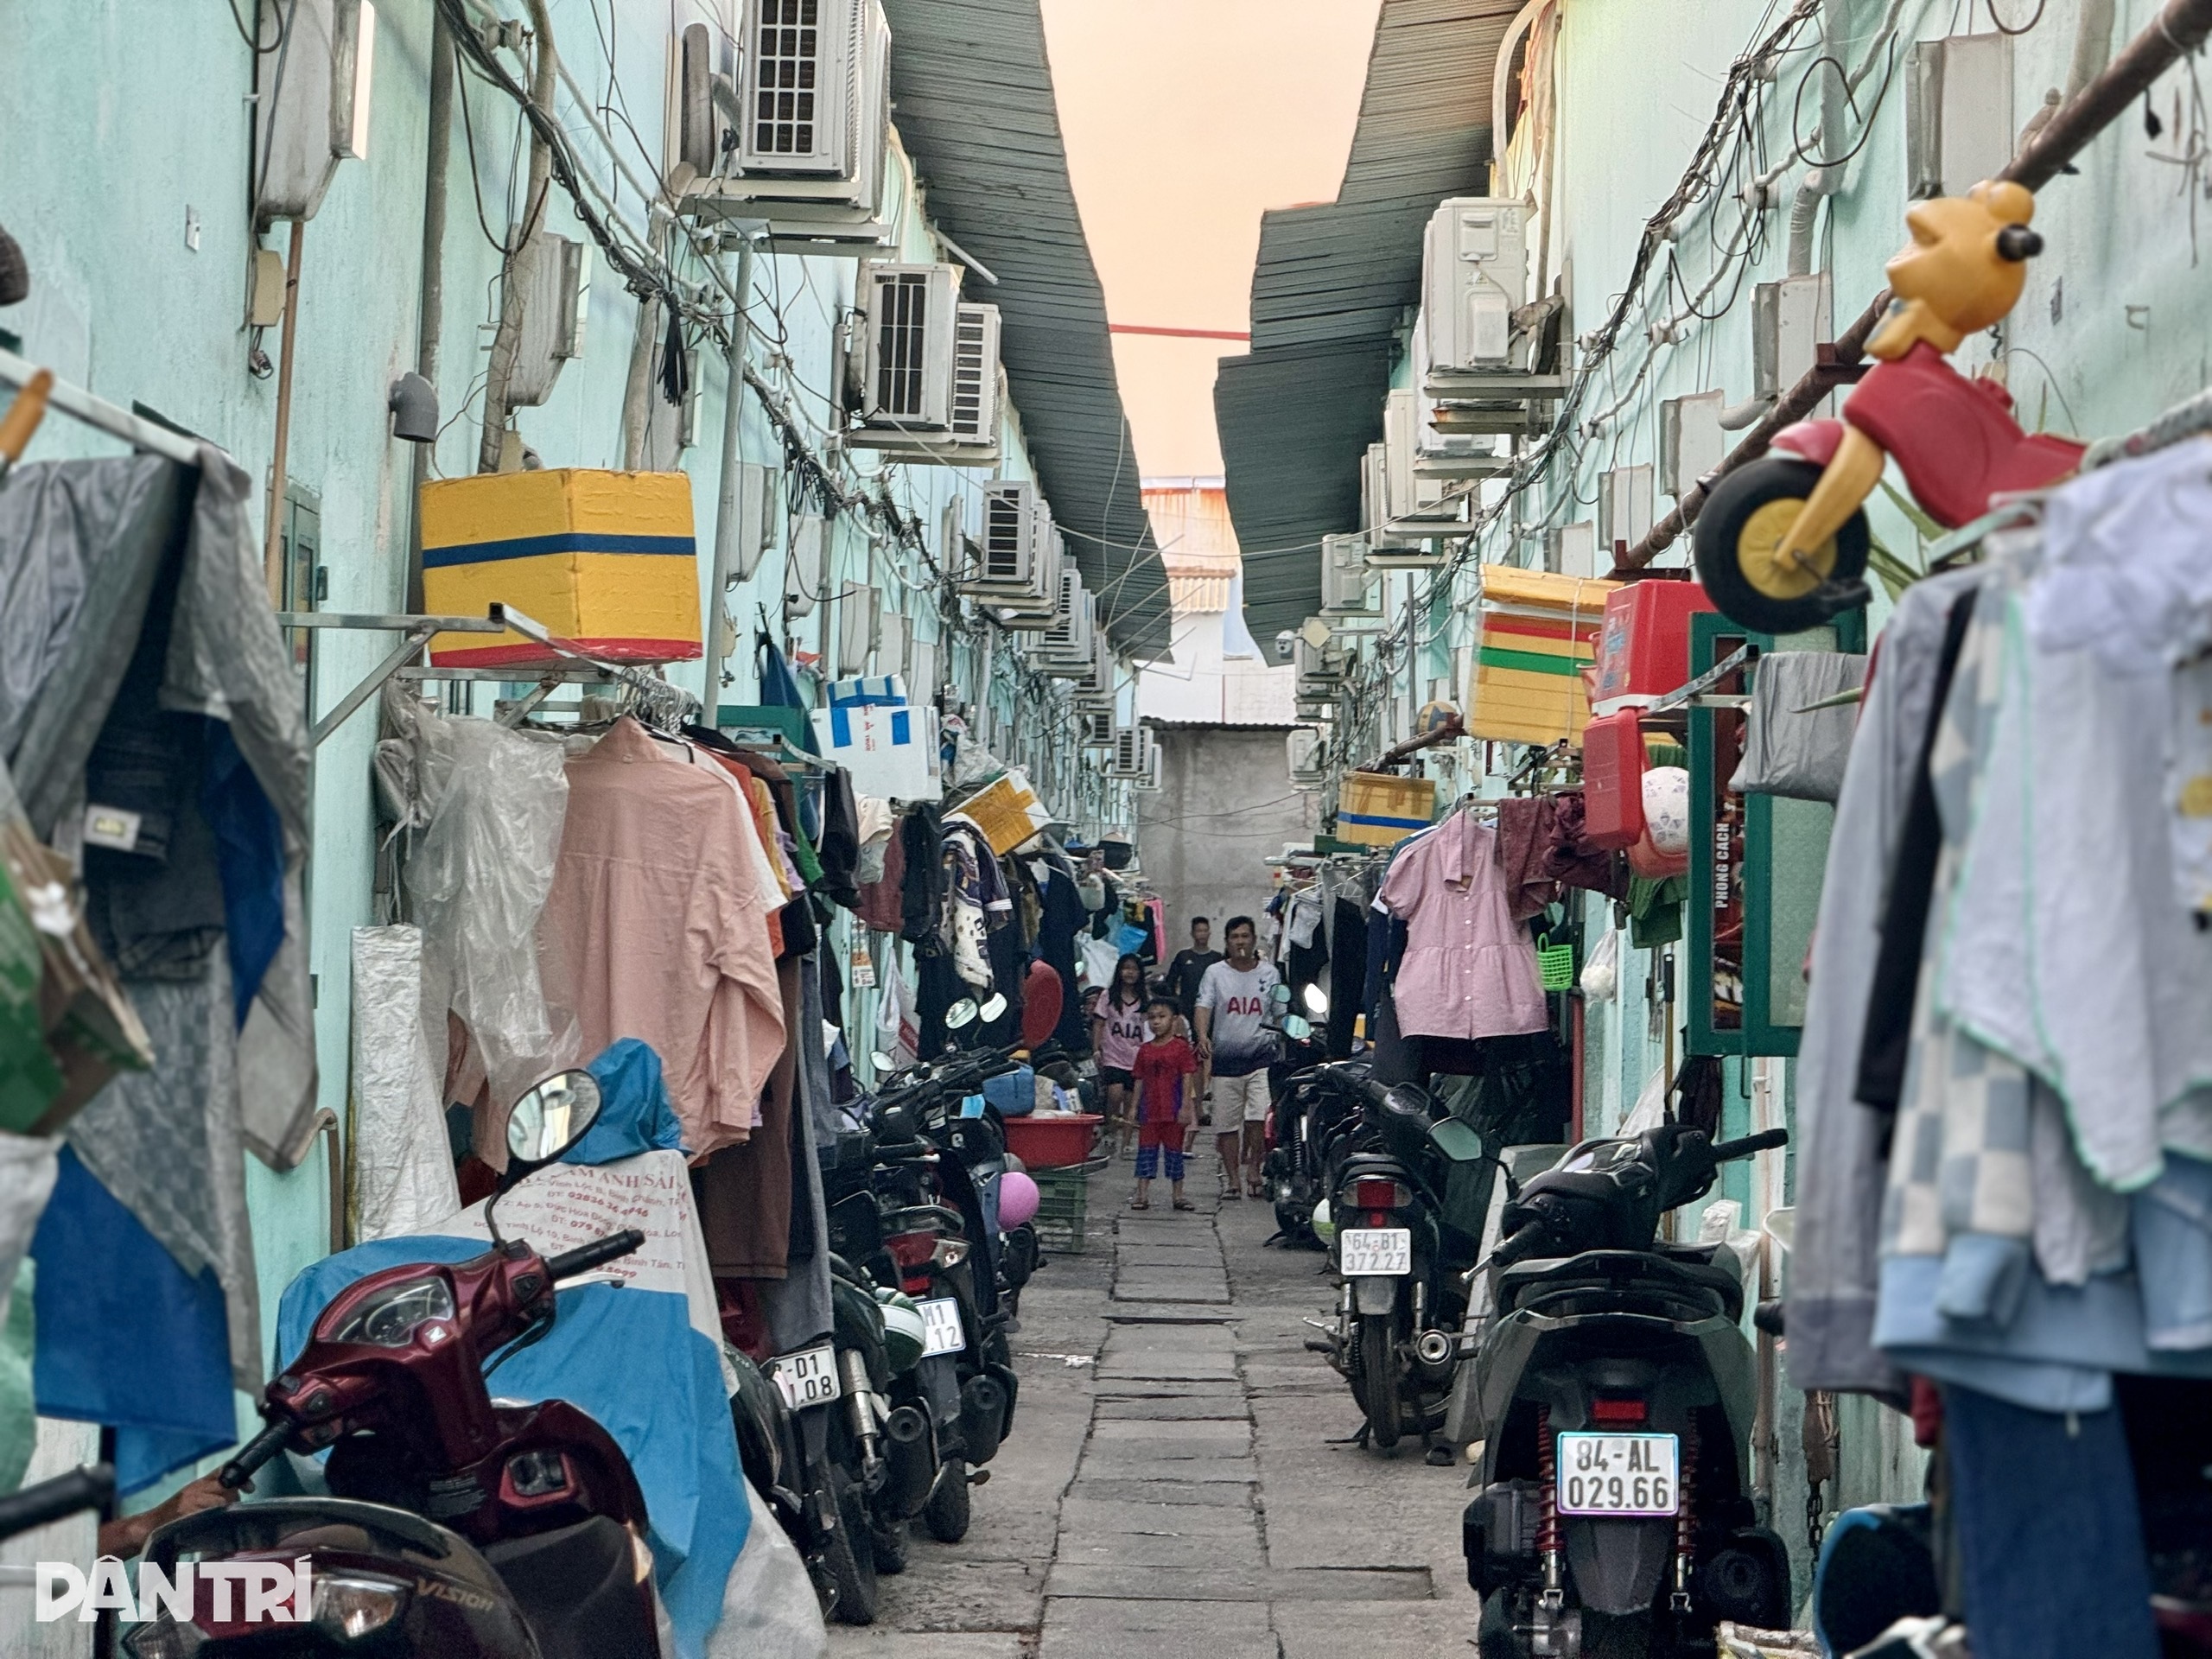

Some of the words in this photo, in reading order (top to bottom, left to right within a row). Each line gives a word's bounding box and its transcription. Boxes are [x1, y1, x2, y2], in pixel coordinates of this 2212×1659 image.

[1715, 863, 1728, 908] PHONG
[1227, 996, 1263, 1016] AIA
[1111, 1020, 1144, 1041] AIA
[1576, 1440, 1661, 1471] 84-AL
[1567, 1475, 1669, 1509] 029.66
